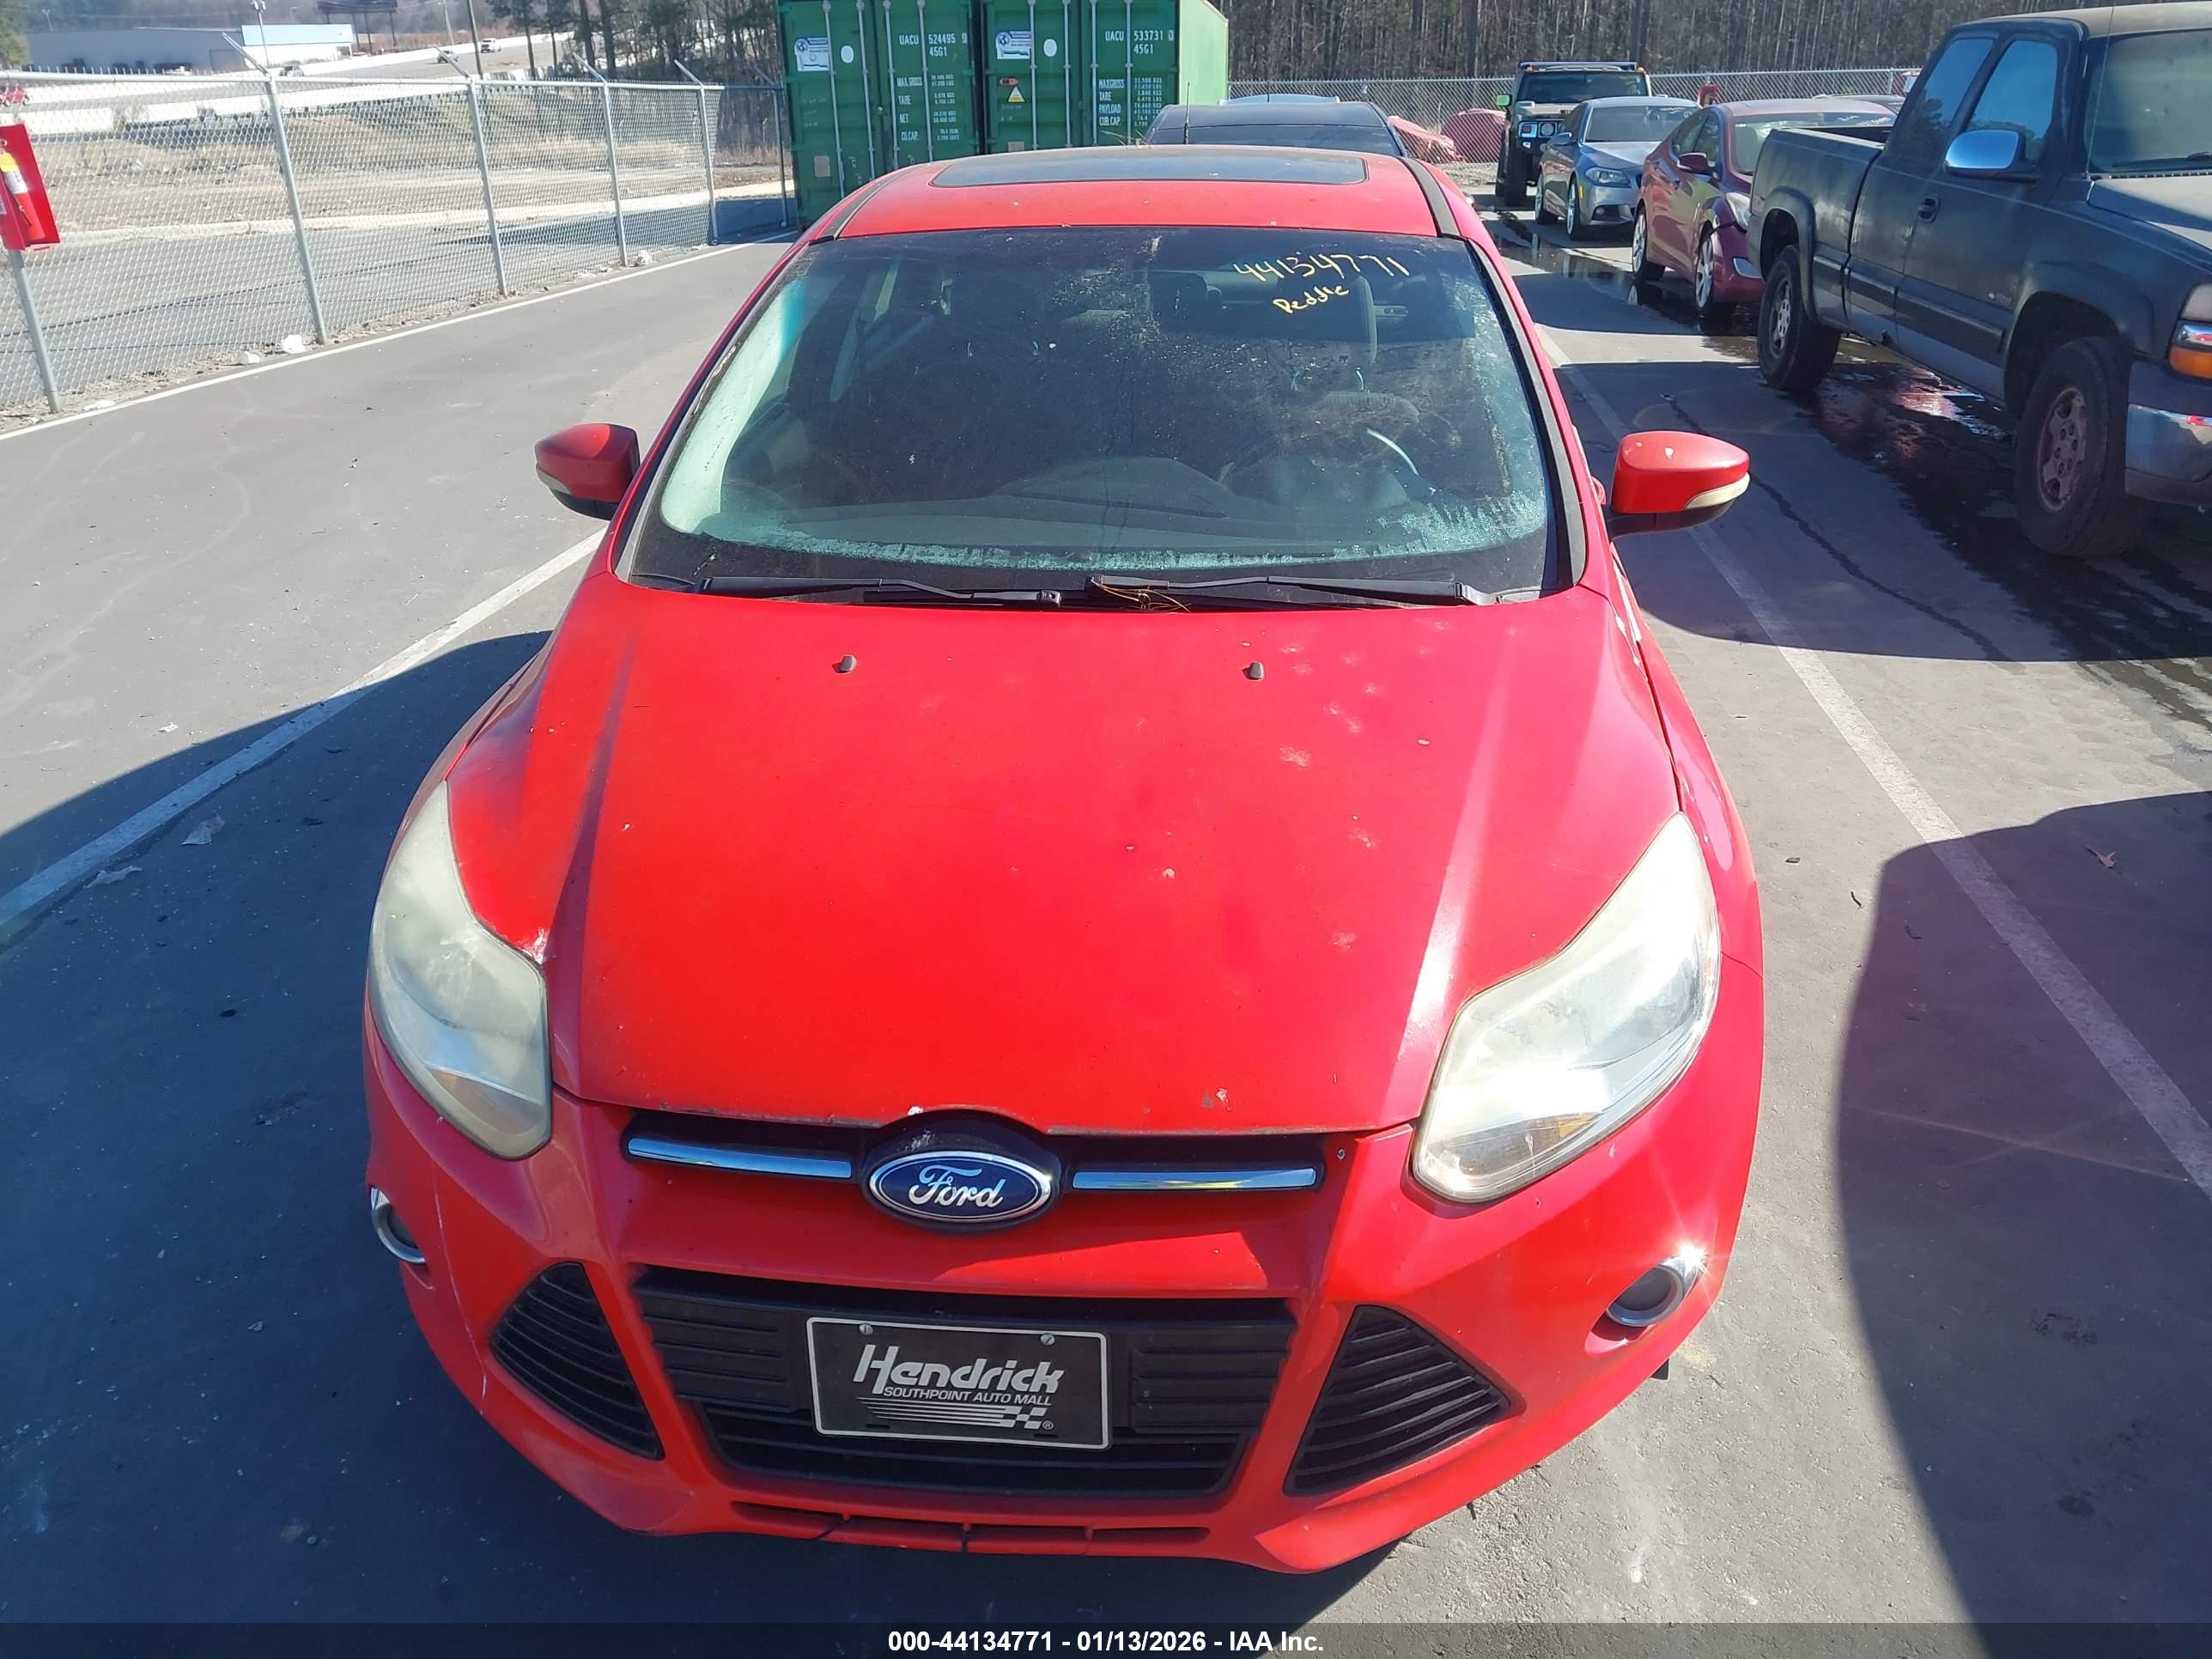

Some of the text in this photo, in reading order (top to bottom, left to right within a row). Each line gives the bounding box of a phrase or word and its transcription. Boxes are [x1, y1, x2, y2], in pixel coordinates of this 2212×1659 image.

[899, 34, 919, 45] UACU
[928, 33, 956, 44] 524495
[1105, 31, 1124, 41] UACU
[1133, 30, 1163, 41] 533731
[929, 46, 947, 57] 45G1
[1133, 43, 1153, 54] 45G1
[898, 95, 911, 105] TARE
[1099, 92, 1112, 101] TARE
[1099, 104, 1121, 113] PAYLOAD
[1233, 252, 1410, 282] 44134771
[908, 1164, 1006, 1207] Ford
[854, 1344, 1066, 1394] Hendrick
[884, 1386, 1053, 1407] SOUTHPOINT AUTO MALL
